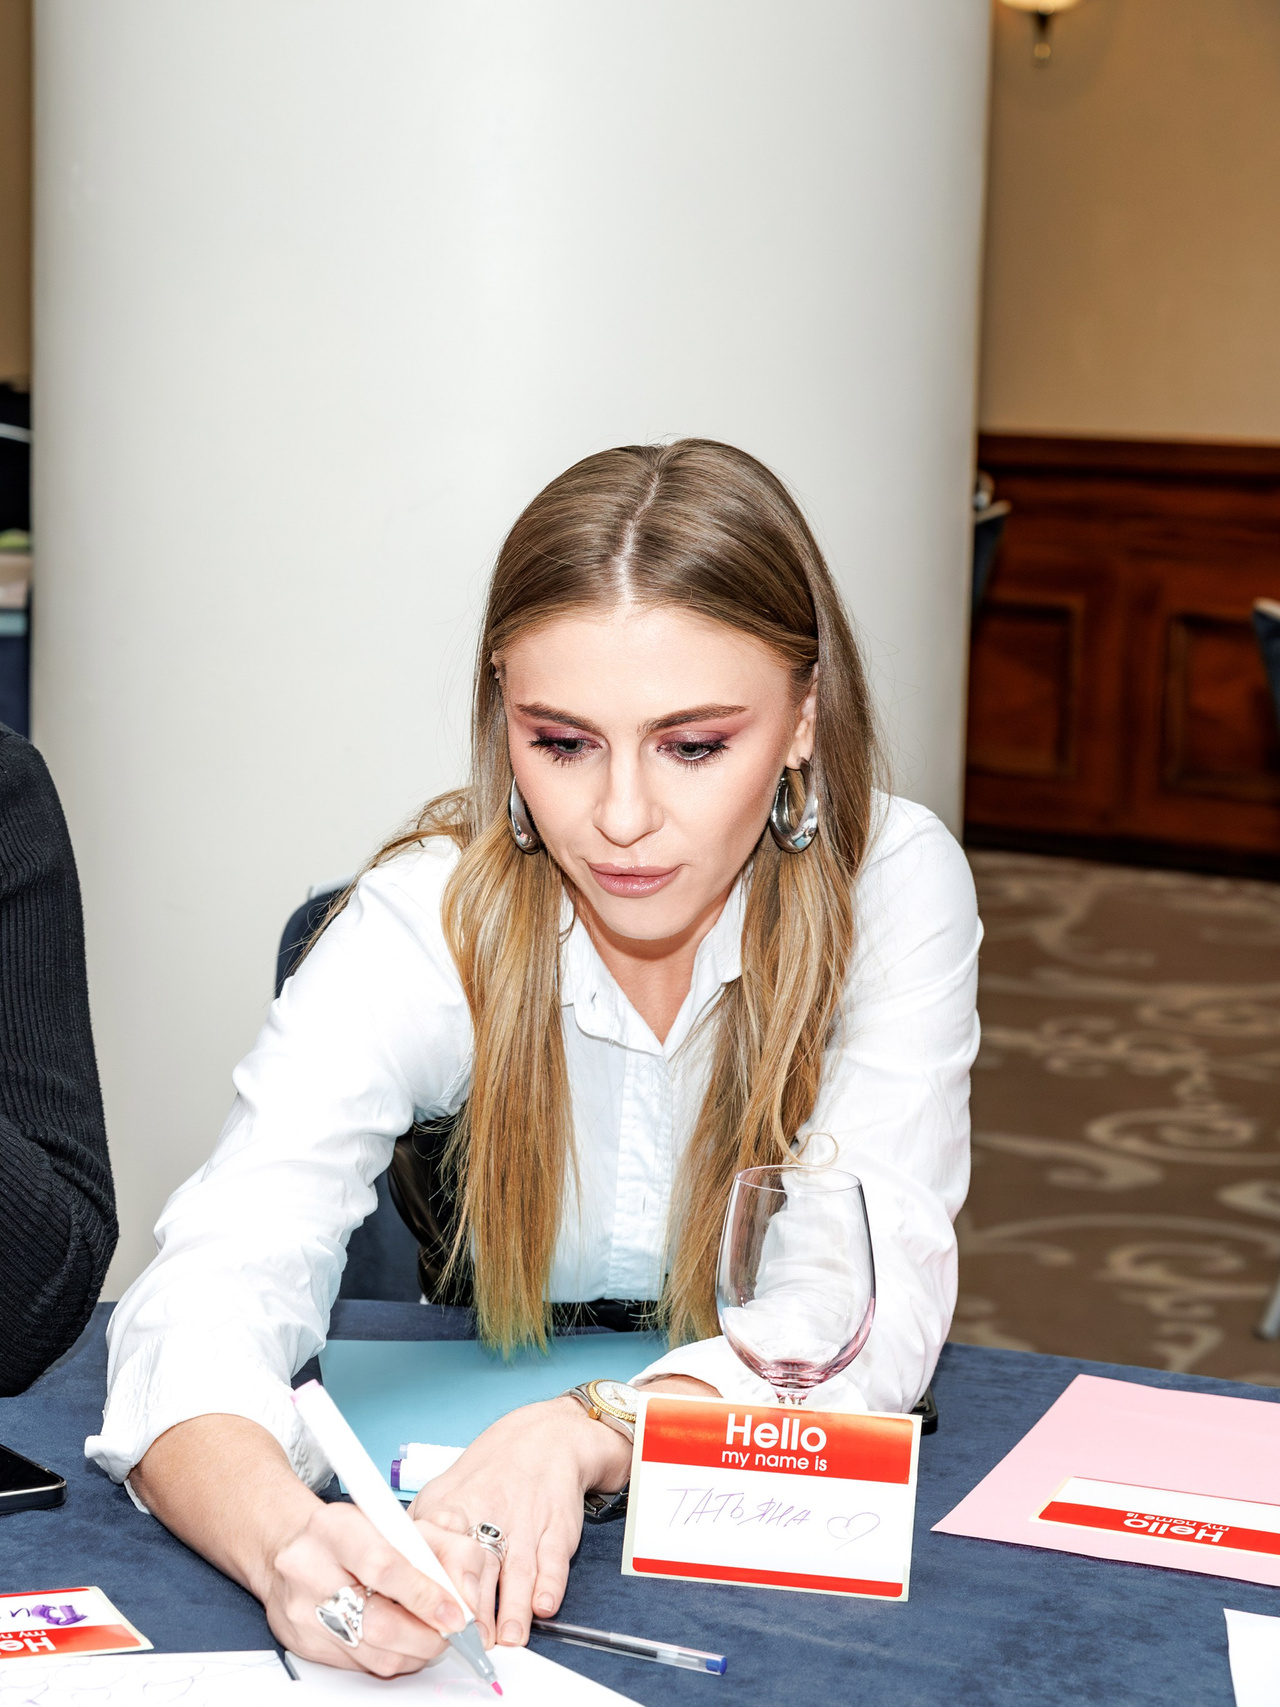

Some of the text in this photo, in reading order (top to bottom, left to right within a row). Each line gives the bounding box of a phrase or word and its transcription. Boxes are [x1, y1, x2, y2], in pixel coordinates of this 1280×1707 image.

[725, 1412, 827, 1453] Hello
[721, 1450, 828, 1472] my name is
[1123, 1518, 1224, 1543] Hello
[1126, 1511, 1230, 1533] my name is
[19, 1629, 46, 1639] my
